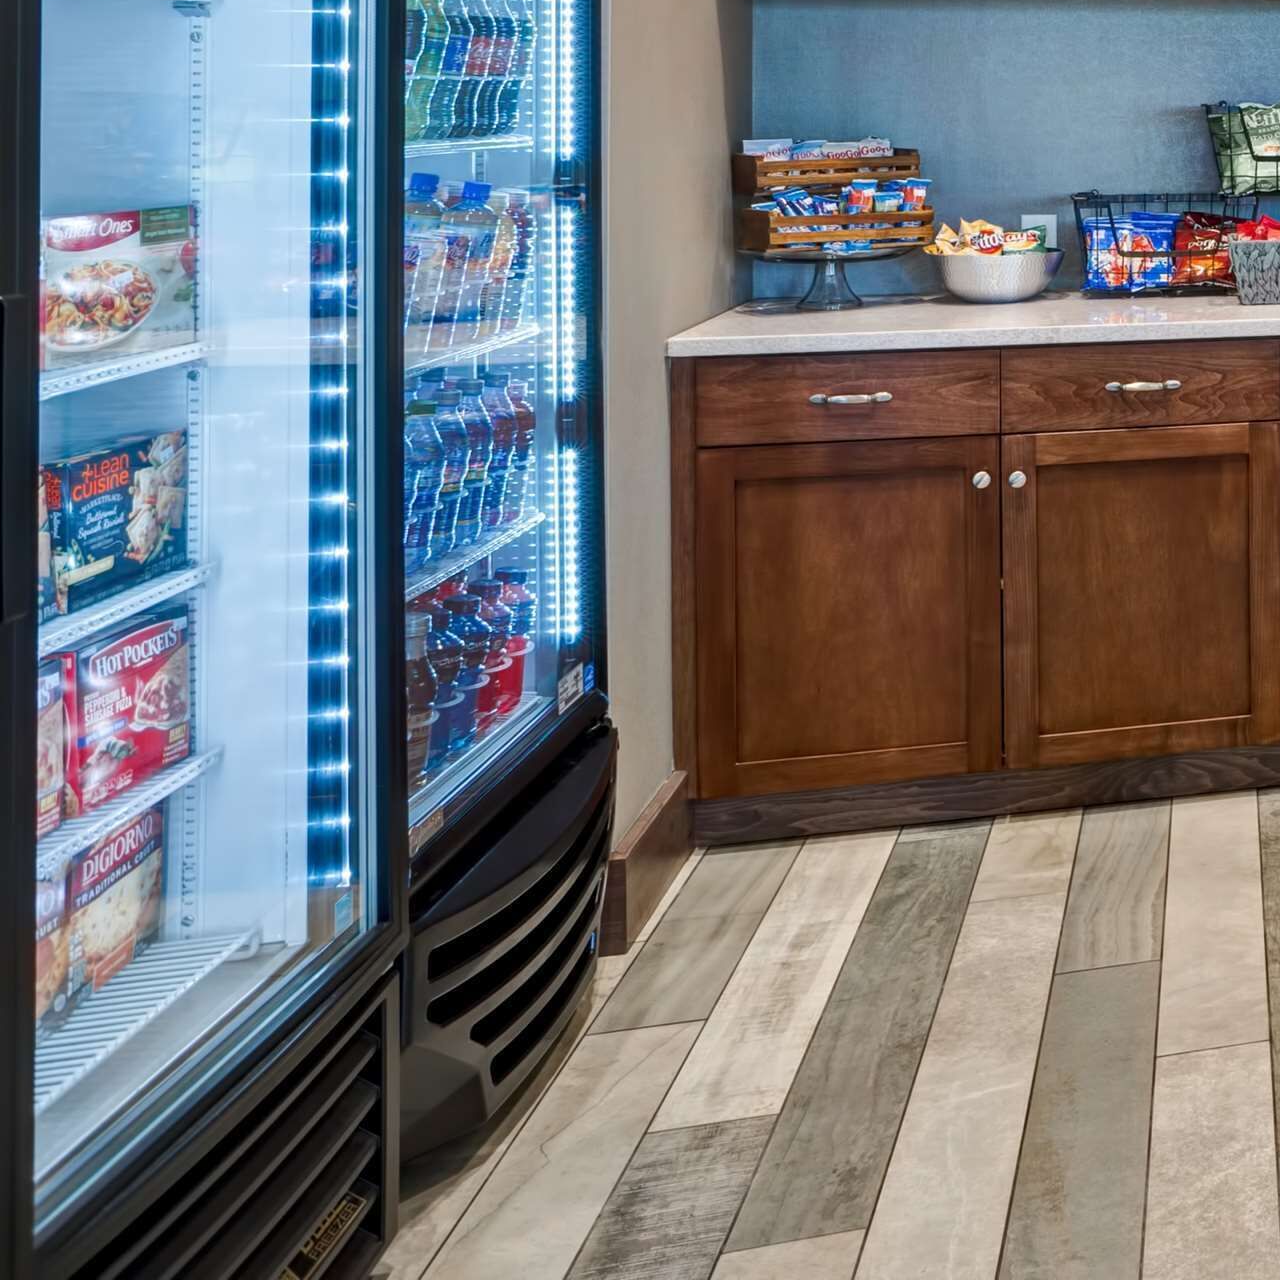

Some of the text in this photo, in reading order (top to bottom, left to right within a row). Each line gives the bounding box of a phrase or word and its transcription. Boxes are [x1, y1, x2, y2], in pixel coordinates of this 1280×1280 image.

[99, 217, 135, 238] Ones
[93, 453, 129, 478] Lean
[95, 626, 178, 678] HOT POCKETS
[82, 815, 154, 883] DIGIORNO
[75, 861, 133, 908] TRADITIONAL
[308, 1202, 358, 1261] FREEZER
